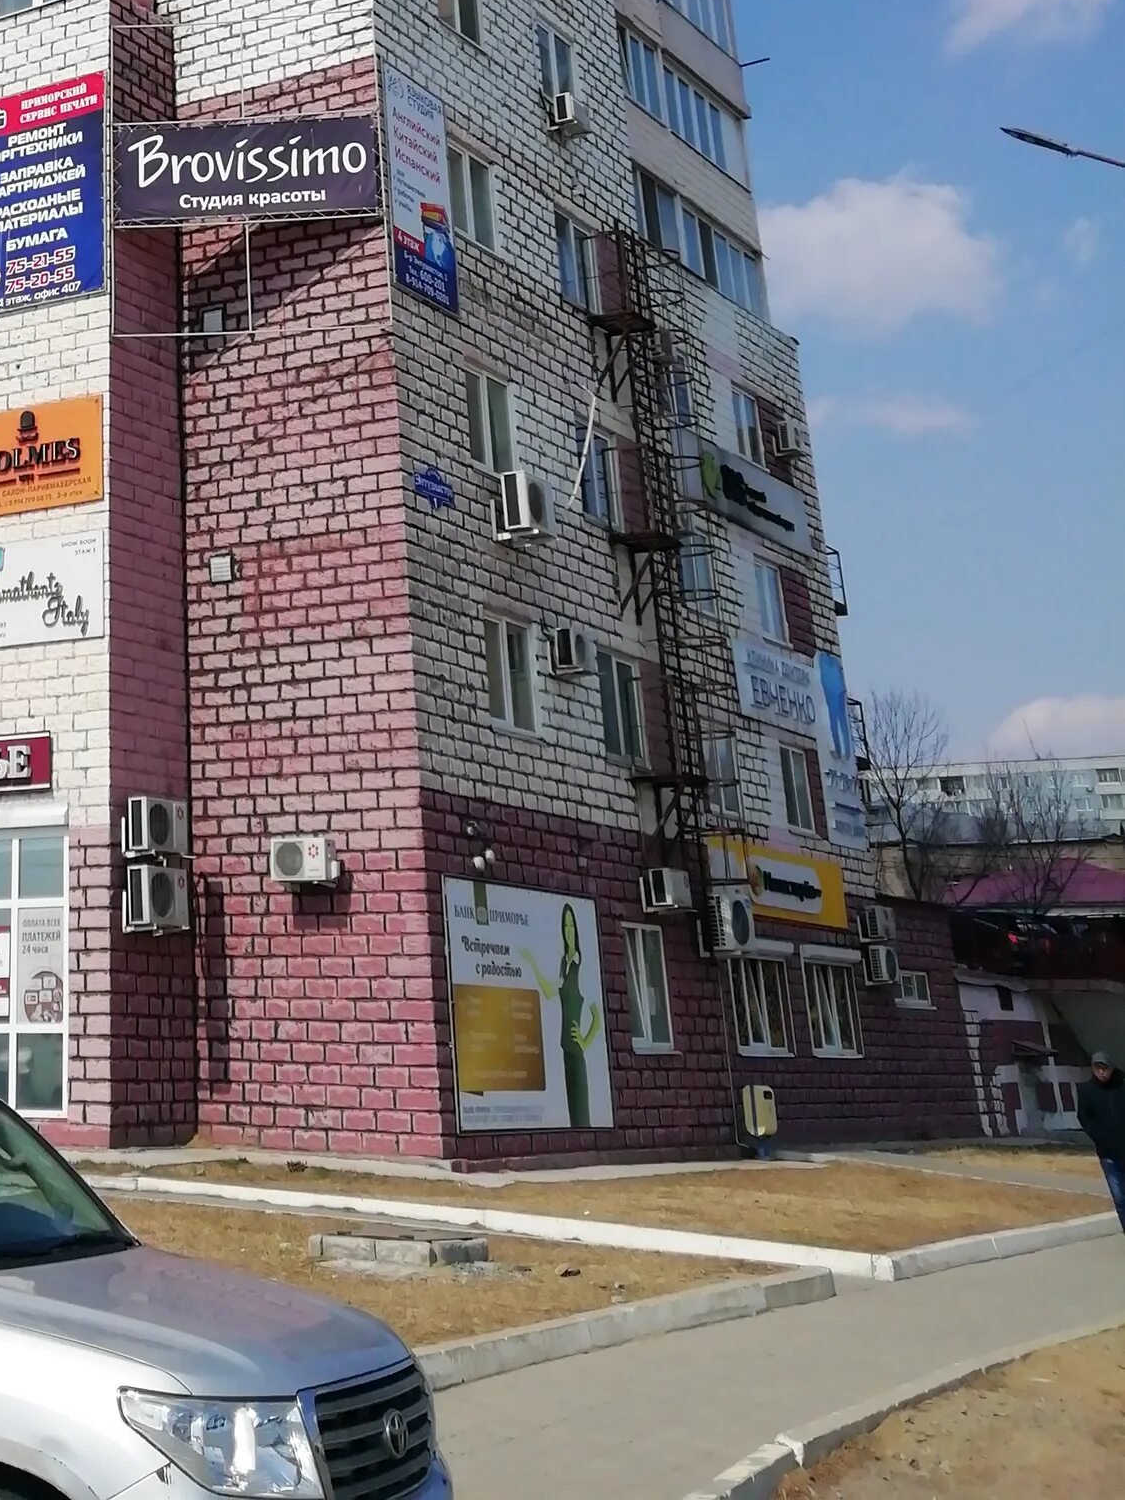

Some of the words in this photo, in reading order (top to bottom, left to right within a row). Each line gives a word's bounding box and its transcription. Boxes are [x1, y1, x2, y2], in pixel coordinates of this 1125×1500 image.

[19, 105, 58, 124] СЕРВИС
[60, 94, 98, 113] ПЕЧАТИ
[21, 82, 87, 110] ПРИМОРСКИЙ
[7, 122, 67, 148] РЕМОНТ
[392, 107, 441, 147] Английский
[393, 125, 439, 165] Китайский
[0, 156, 74, 185] ЗАПРАВКА
[127, 134, 367, 189] Brovissimo
[394, 146, 441, 186] Испанский
[179, 193, 243, 211] Студия
[249, 189, 326, 207] красоты
[5, 227, 69, 252] БУМАГА
[397, 231, 403, 242] 4
[5, 245, 76, 276] 75-21-55
[4, 264, 75, 295] 75-20-55
[34, 287, 60, 301] офис
[61, 280, 82, 293] 407
[42, 595, 90, 637] Italy
[750, 674, 816, 725] ЕВЧЕНКО
[23, 919, 45, 928] ОПЛАТА
[454, 904, 475, 920] БАНК
[490, 909, 529, 927] ПРИМОРЬЕ
[22, 930, 61, 942] ПЛАТЕЖЕЙ
[22, 944, 31, 954] 24
[32, 945, 49, 954] часа
[475, 963, 480, 974] с
